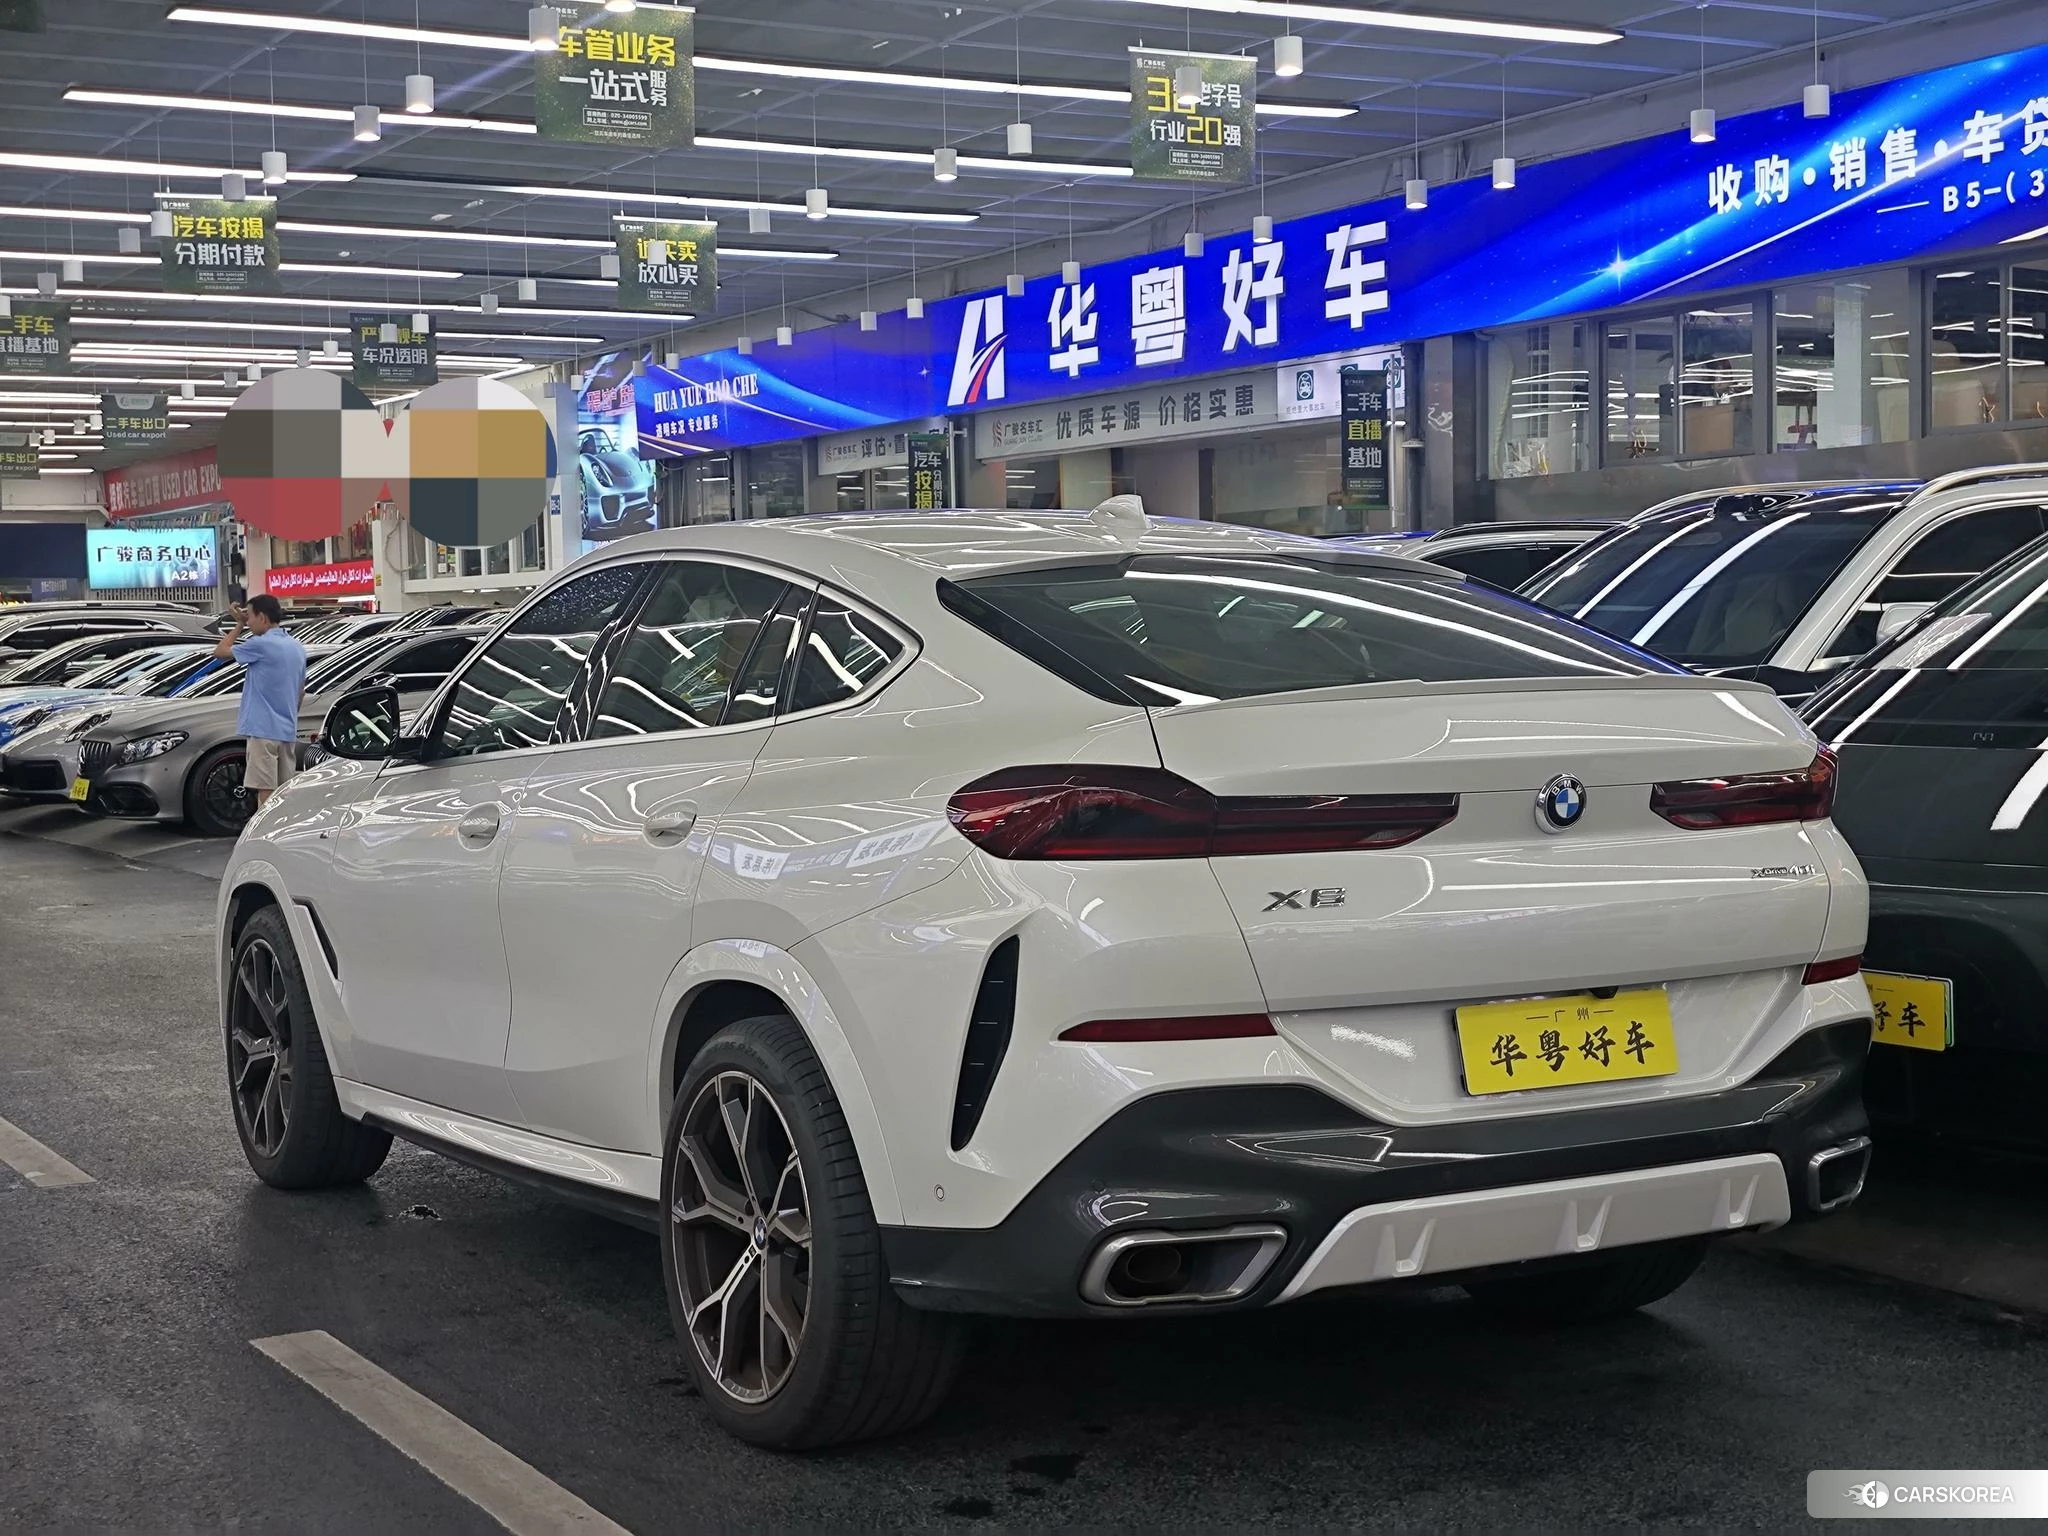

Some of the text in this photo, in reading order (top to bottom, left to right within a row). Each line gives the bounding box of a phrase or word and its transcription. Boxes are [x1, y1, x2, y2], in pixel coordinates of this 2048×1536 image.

[559, 26, 676, 67] 车管业务
[1150, 115, 1242, 147] 行业20强
[173, 214, 264, 239] 汽车按揭
[174, 242, 266, 266] 分期付款
[638, 262, 698, 285] 放心买
[1047, 220, 1390, 378] 华粤好车
[362, 346, 428, 364] 车况透明
[653, 389, 679, 413] HUA
[679, 385, 703, 408] YUE
[705, 379, 731, 404] HAO
[732, 373, 759, 398] CHE
[1347, 392, 1382, 411] 二手车
[106, 417, 166, 429] 二手车出口
[1056, 384, 1254, 440] 优质车源 价格实惠
[1347, 419, 1382, 440] 直播
[914, 451, 942, 467] 汽车
[1348, 447, 1382, 468] 基地
[161, 472, 181, 500] USED
[183, 468, 199, 497] CAR
[97, 545, 211, 562] 广骏商务中心
[1551, 779, 1583, 796] BMW
[1261, 887, 1346, 912] X6
[1490, 1020, 1655, 1077] 华粤好车
